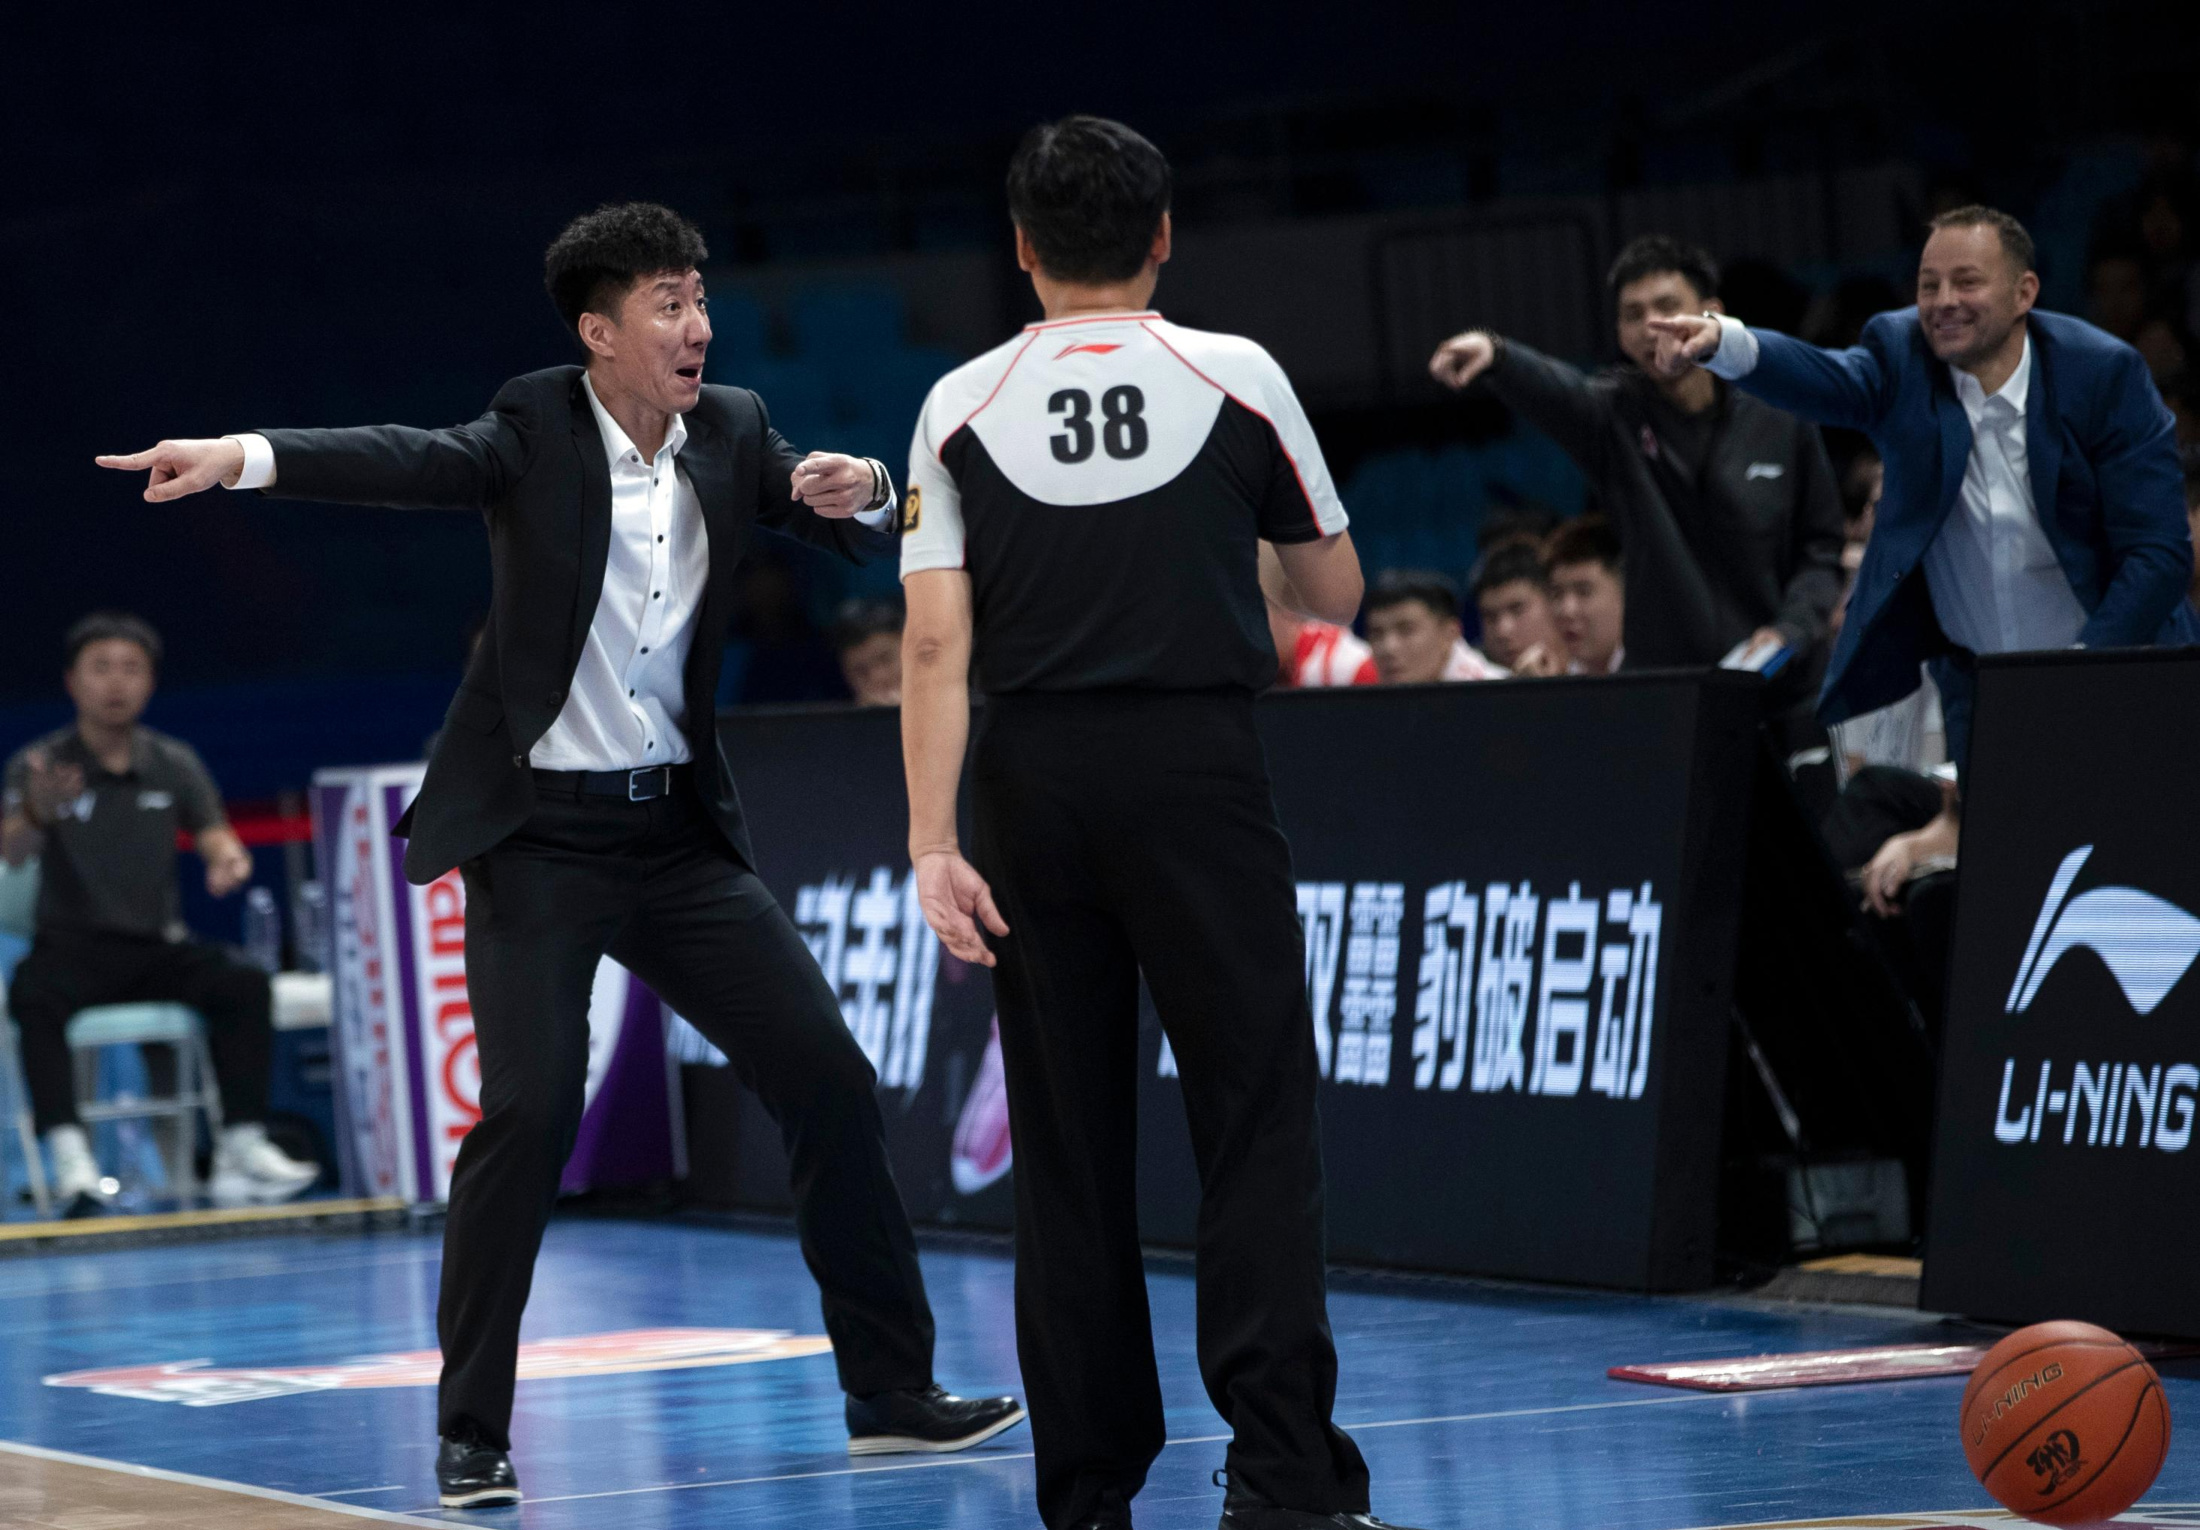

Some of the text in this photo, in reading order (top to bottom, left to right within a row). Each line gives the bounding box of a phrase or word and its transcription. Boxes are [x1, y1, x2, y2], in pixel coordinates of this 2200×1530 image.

[1047, 384, 1149, 464] 38
[1994, 1057, 2200, 1153] LI-NING
[1971, 1362, 2064, 1447] LI-NING
